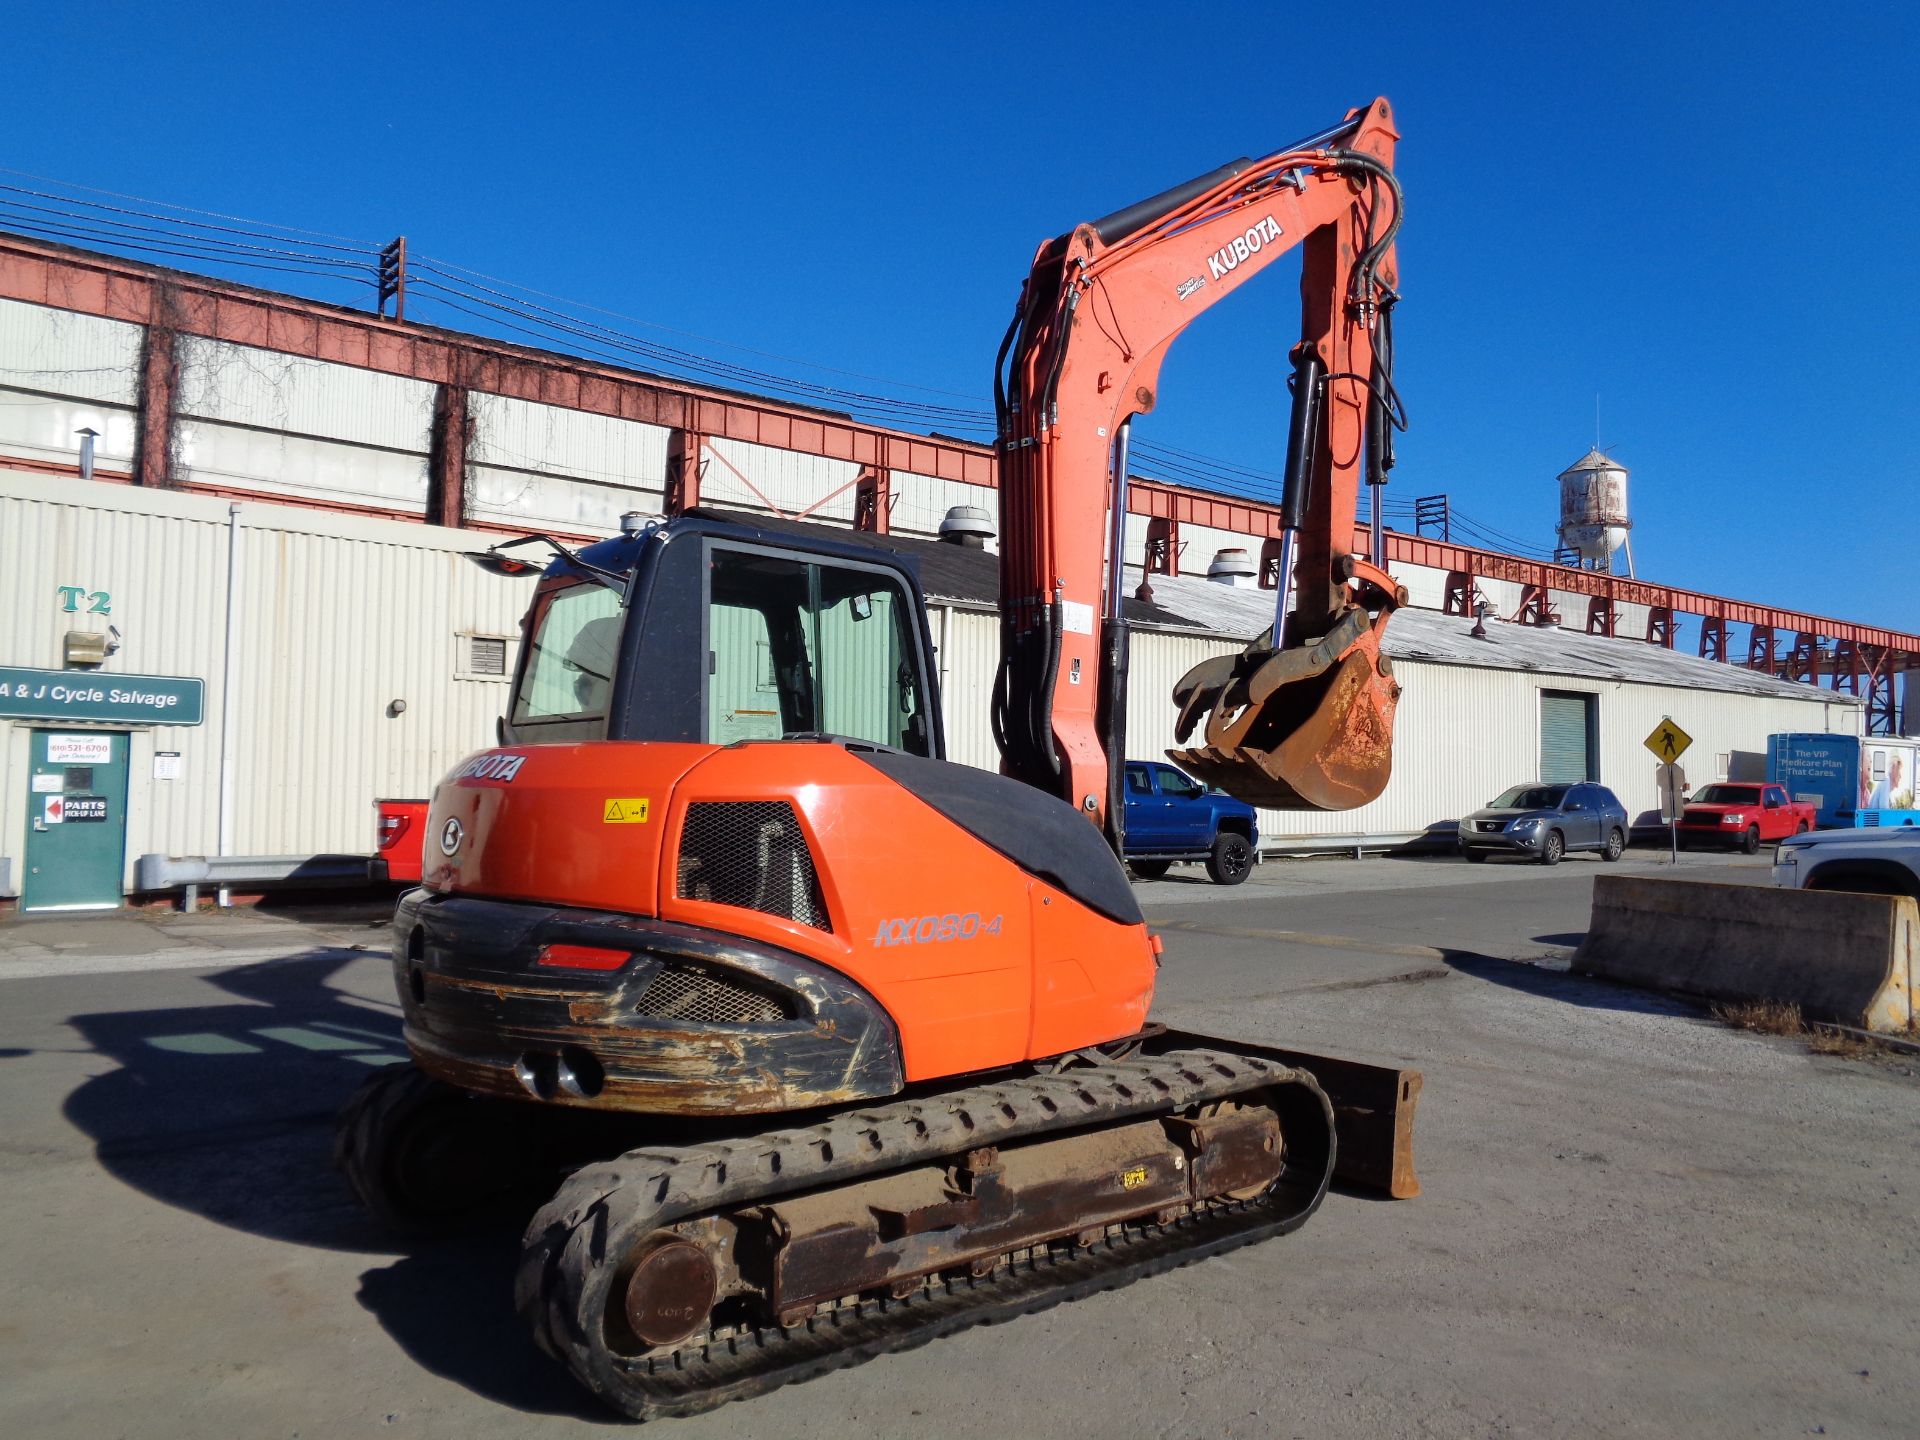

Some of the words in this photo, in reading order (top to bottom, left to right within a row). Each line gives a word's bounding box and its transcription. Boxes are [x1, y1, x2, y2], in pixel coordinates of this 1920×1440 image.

[1207, 215, 1284, 281] KUBOTA
[57, 584, 112, 616] T2
[0, 682, 10, 697] A
[14, 684, 29, 698] &
[33, 685, 47, 699] J
[51, 686, 104, 704] Cycle
[109, 689, 177, 708] Salvage
[449, 754, 528, 782] UBOTA
[1822, 760, 1843, 768] Plan
[65, 801, 105, 810] PARTS
[874, 912, 1004, 948] KX080-4
